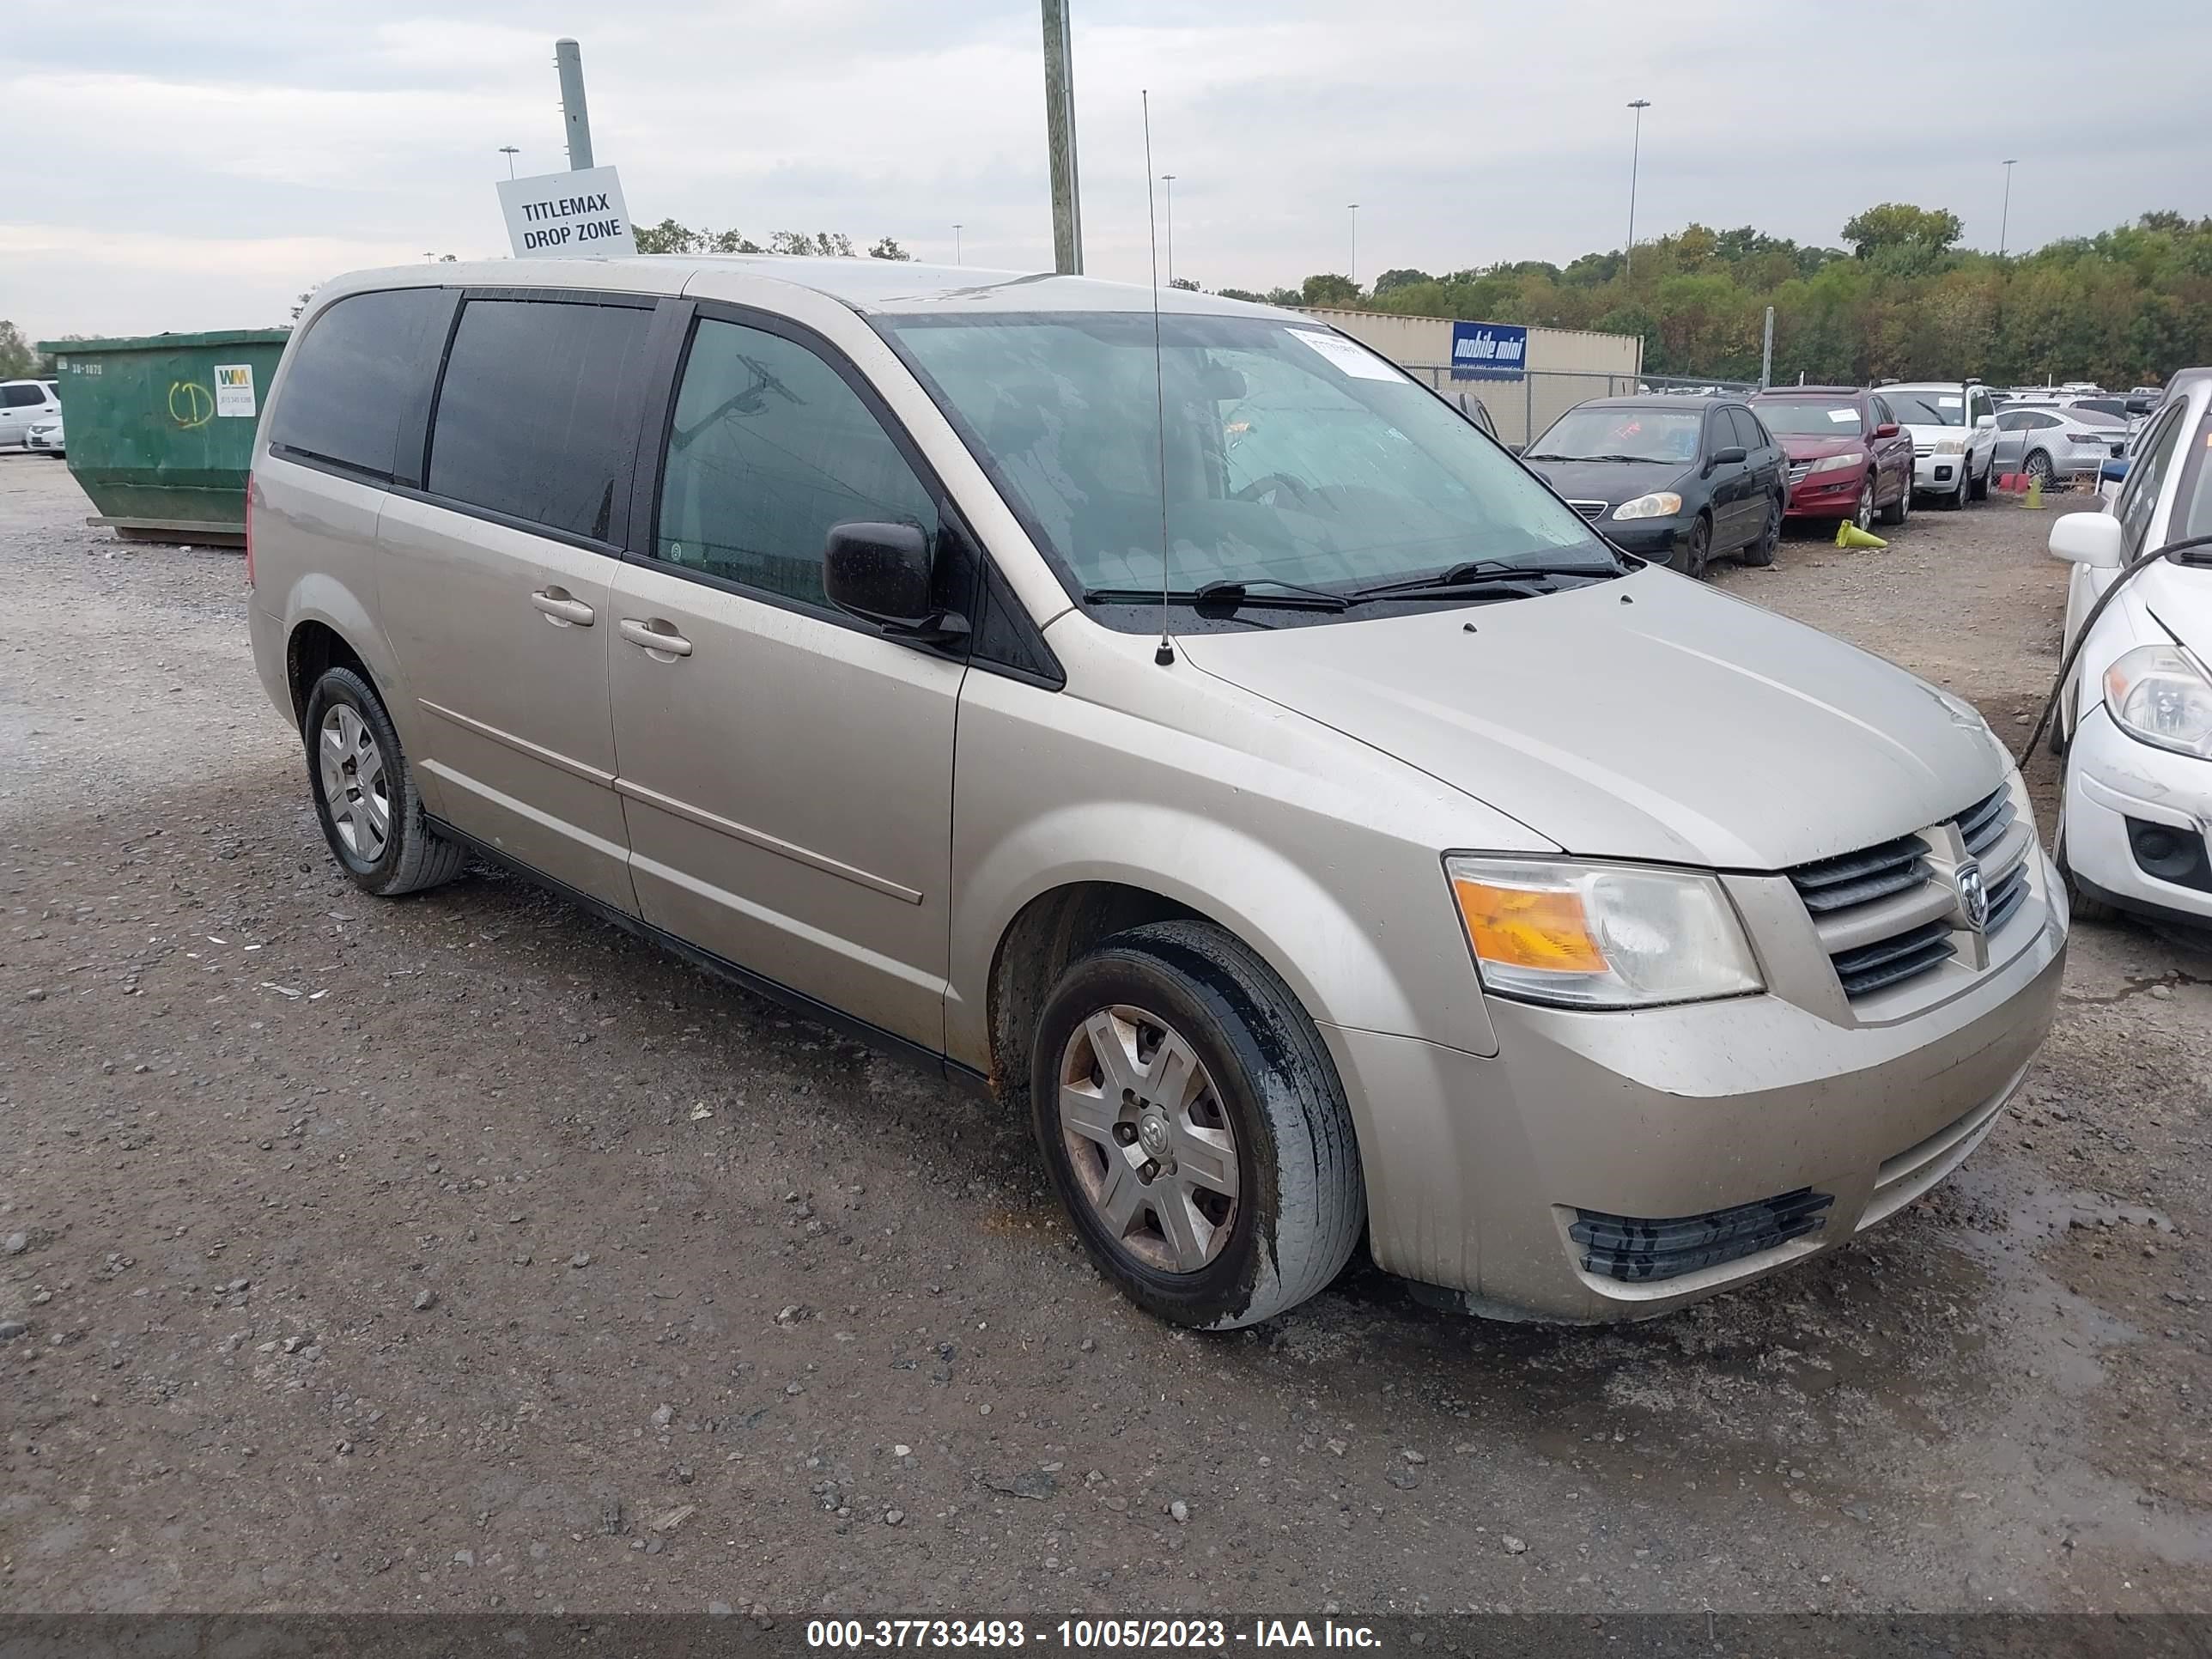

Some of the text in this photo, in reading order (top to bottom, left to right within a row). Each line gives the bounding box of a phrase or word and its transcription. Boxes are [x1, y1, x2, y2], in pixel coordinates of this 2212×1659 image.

[522, 193, 611, 222] TITLEMAX
[524, 218, 623, 249] DROP ZONE
[1454, 330, 1525, 360] mobile mini
[219, 369, 249, 386] WM
